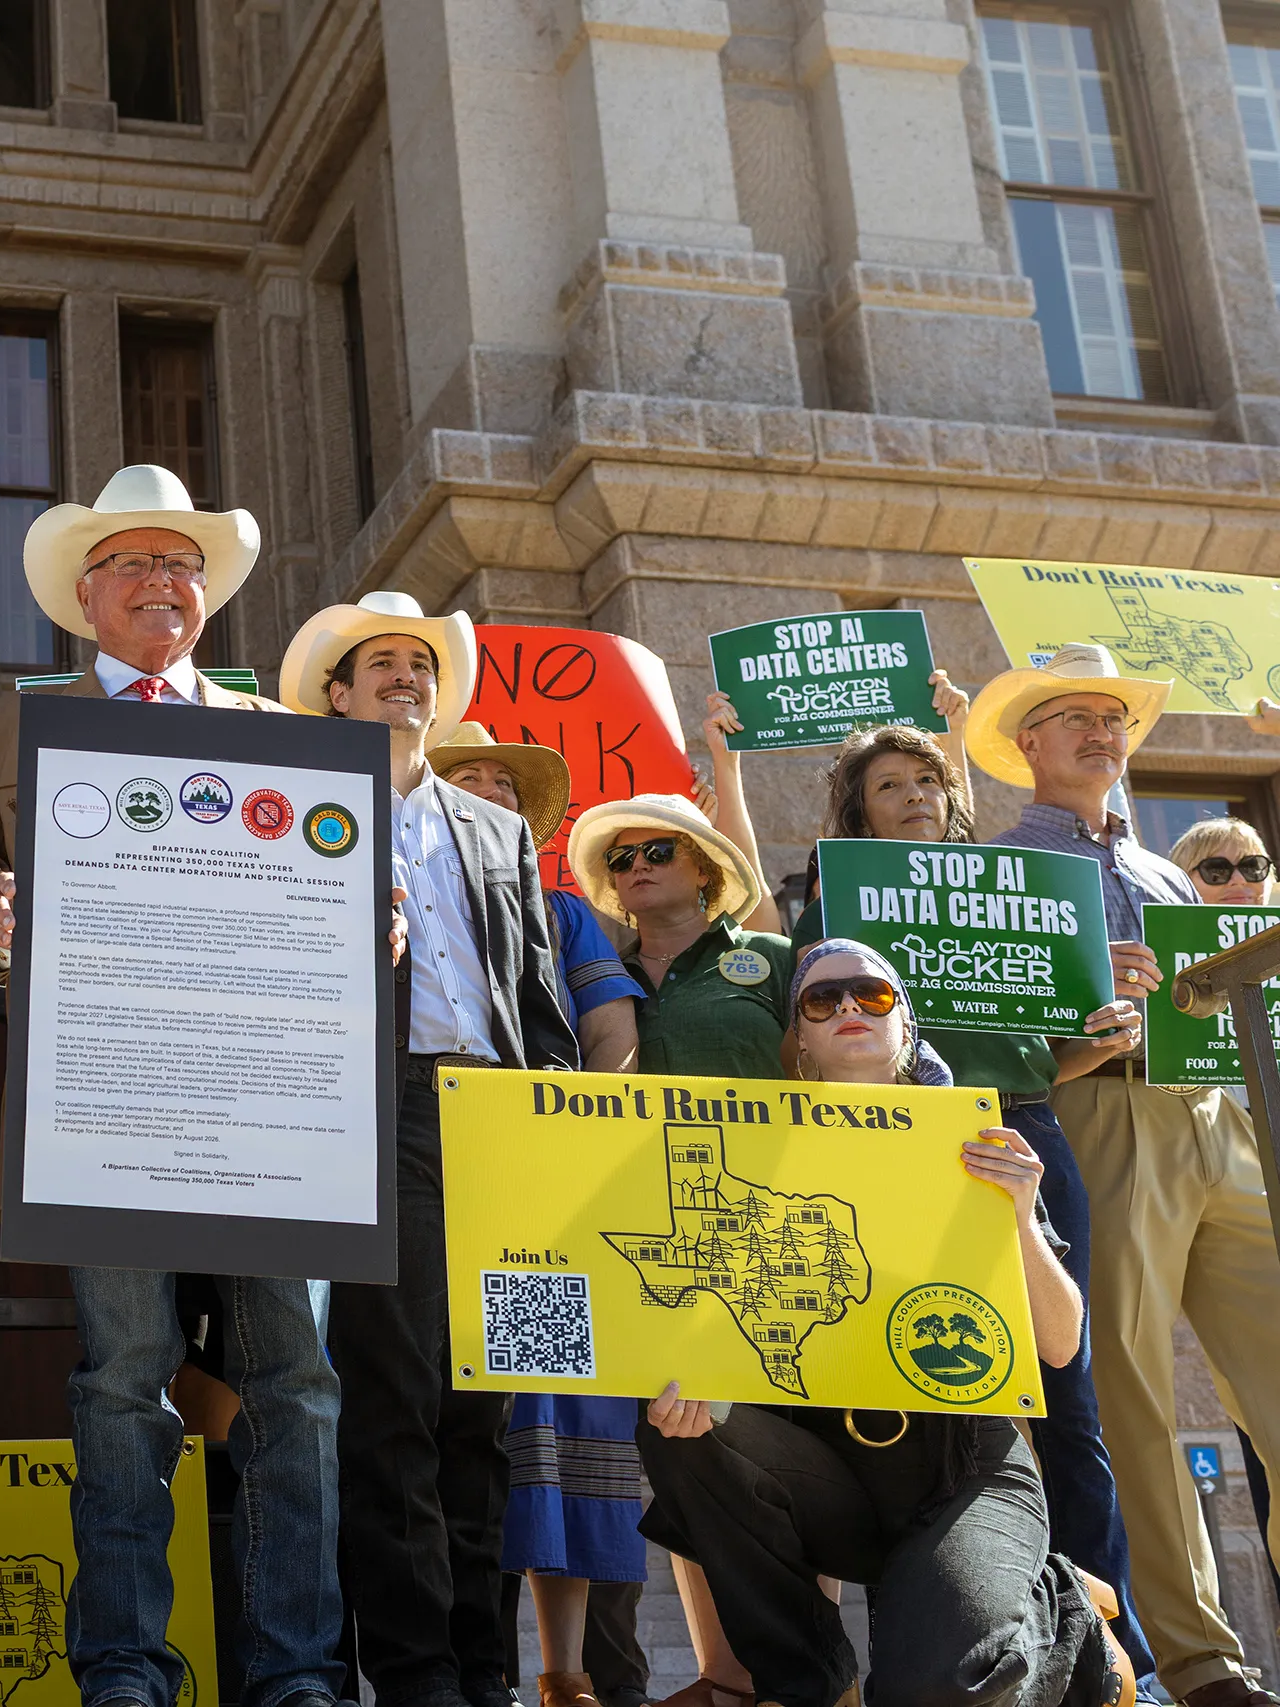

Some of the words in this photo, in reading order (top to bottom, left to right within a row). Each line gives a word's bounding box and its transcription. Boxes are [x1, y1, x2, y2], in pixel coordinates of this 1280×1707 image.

[1021, 564, 1097, 585] Don't
[1098, 569, 1164, 589] Ruin
[1165, 573, 1245, 596] Texas
[774, 620, 833, 650] STOP
[841, 617, 865, 645] AI
[739, 652, 802, 683] DATA
[806, 642, 908, 676] CENTERS
[801, 676, 890, 696] CLAYTON
[767, 688, 893, 714] TUCKER
[774, 716, 791, 724] FOR
[792, 713, 809, 722] AG
[810, 704, 895, 721] COMMISSIONER
[756, 728, 785, 740] FOOD
[816, 722, 854, 735] WATER
[195, 803, 218, 811] TEXAS
[243, 789, 282, 809] CONSERVATIVE
[314, 811, 347, 825] CALDWELL
[115, 852, 182, 863] REPRESENTING
[186, 857, 224, 866] 350,000
[226, 861, 255, 869] TEXAS
[258, 863, 293, 872] VOTERS
[152, 845, 207, 855] BIPARTISAN
[210, 849, 260, 859] COALITION
[64, 859, 110, 868] DEMANDS
[140, 865, 176, 873] CENTER
[178, 868, 241, 878] MORATORIUM
[266, 875, 303, 883] SPECIAL
[306, 878, 345, 887] SESSION
[908, 849, 985, 888] STOP
[996, 855, 1026, 892] AI
[286, 894, 320, 902] DELIVERED
[858, 886, 939, 926] DATA
[948, 890, 1079, 937] CENTERS
[733, 954, 755, 962] NO
[937, 938, 1052, 961] CLAYTON
[723, 962, 760, 974] 765
[891, 942, 1055, 985] TUCKER
[902, 979, 918, 988] OR
[920, 977, 942, 990] AG
[943, 979, 1056, 998] COMMISSIONER
[951, 1000, 999, 1016] WATER
[1043, 1006, 1079, 1020] LAND
[936, 1017, 957, 1025] Clayton
[1207, 1041, 1226, 1049] FOR
[1185, 1057, 1218, 1069] FOOD
[530, 1080, 654, 1120] Don't
[660, 1086, 774, 1127] Ruin
[780, 1091, 914, 1132] Texas
[60, 1126, 84, 1134] Arrange
[183, 1134, 204, 1142] August
[173, 1150, 194, 1158] Signed
[201, 1152, 230, 1160] Solidarity,
[107, 1163, 140, 1171] Bipartisan
[140, 1165, 171, 1173] Collective
[179, 1167, 212, 1176] Coalitions,
[213, 1170, 255, 1180] Organizations
[262, 1173, 302, 1181] Associations
[149, 1174, 190, 1184] Representing
[498, 1247, 538, 1267] Join
[541, 1249, 569, 1267] Us
[898, 1289, 939, 1322] COUNTRY
[943, 1289, 1007, 1355] PRESERVATION
[895, 1326, 904, 1350] HILL
[912, 1371, 998, 1397] COALITION
